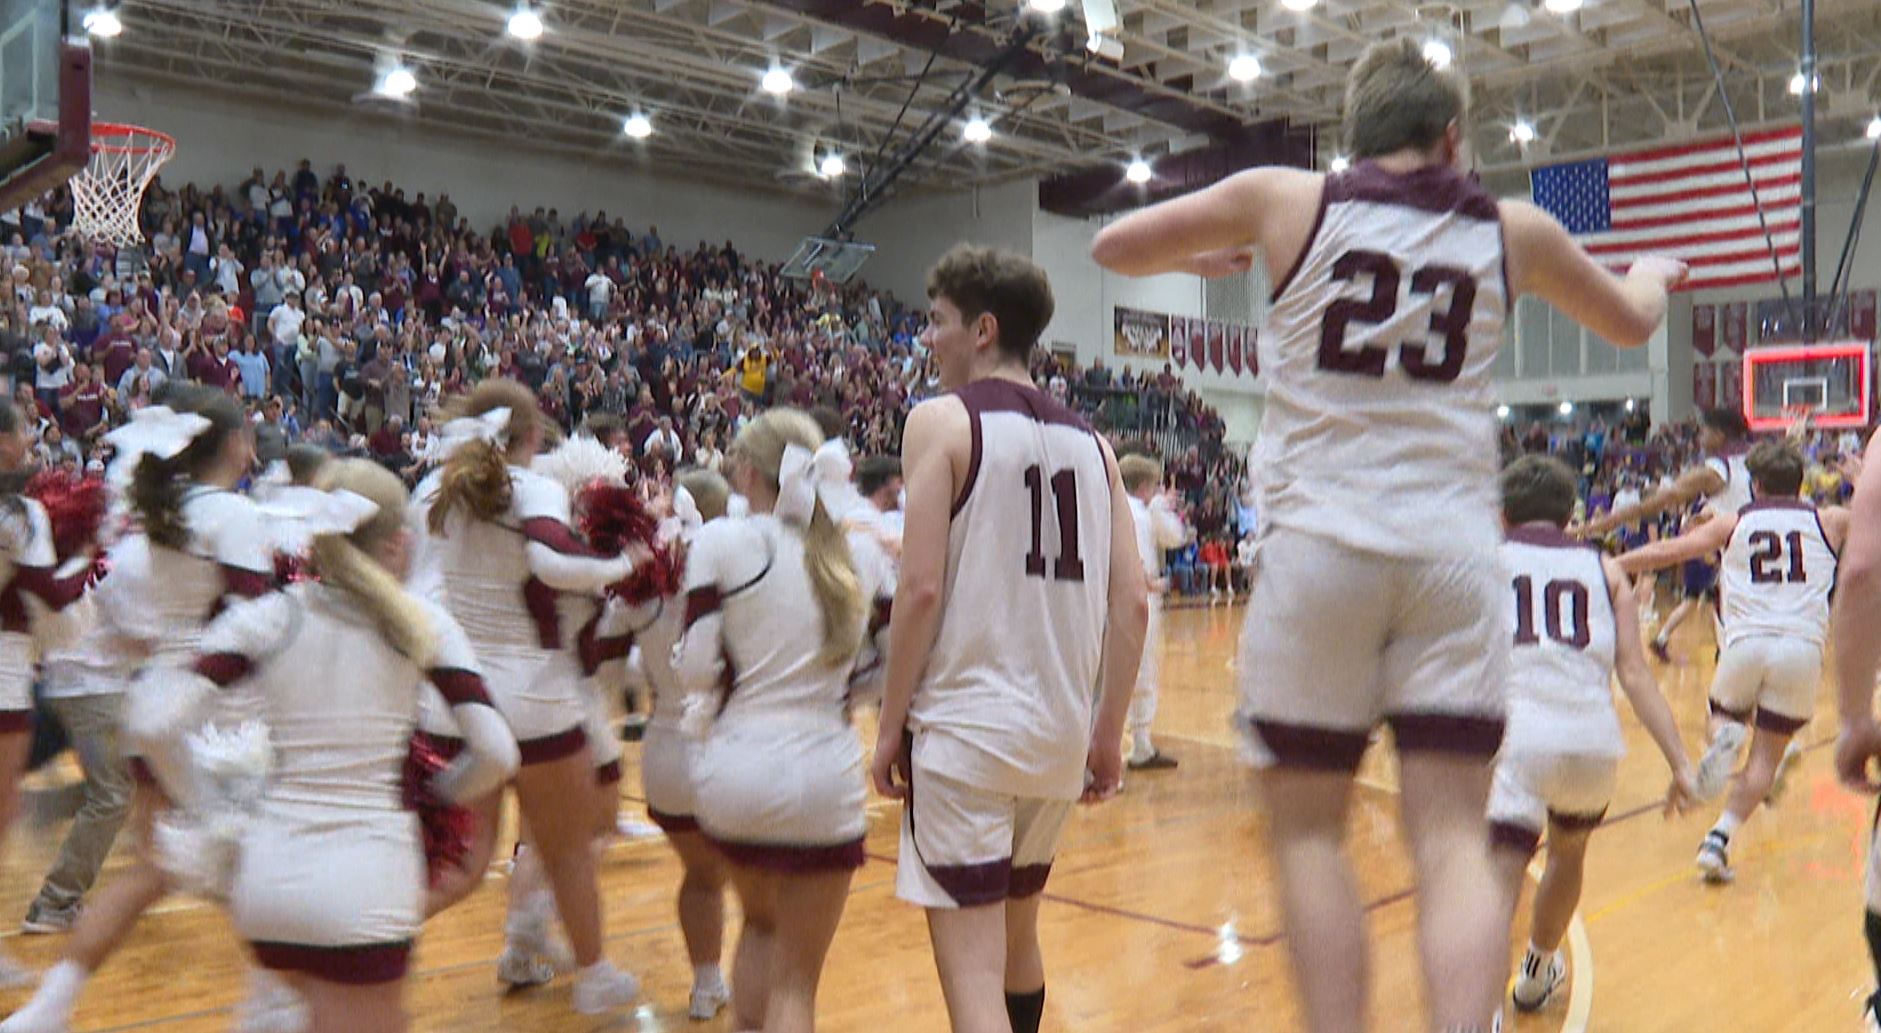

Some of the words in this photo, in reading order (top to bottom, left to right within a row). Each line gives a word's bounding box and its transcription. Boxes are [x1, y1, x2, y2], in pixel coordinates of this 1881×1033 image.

[1318, 249, 1476, 382] 23
[1024, 464, 1084, 582] 11
[1749, 530, 1806, 584] 21
[1512, 575, 1590, 649] 10
